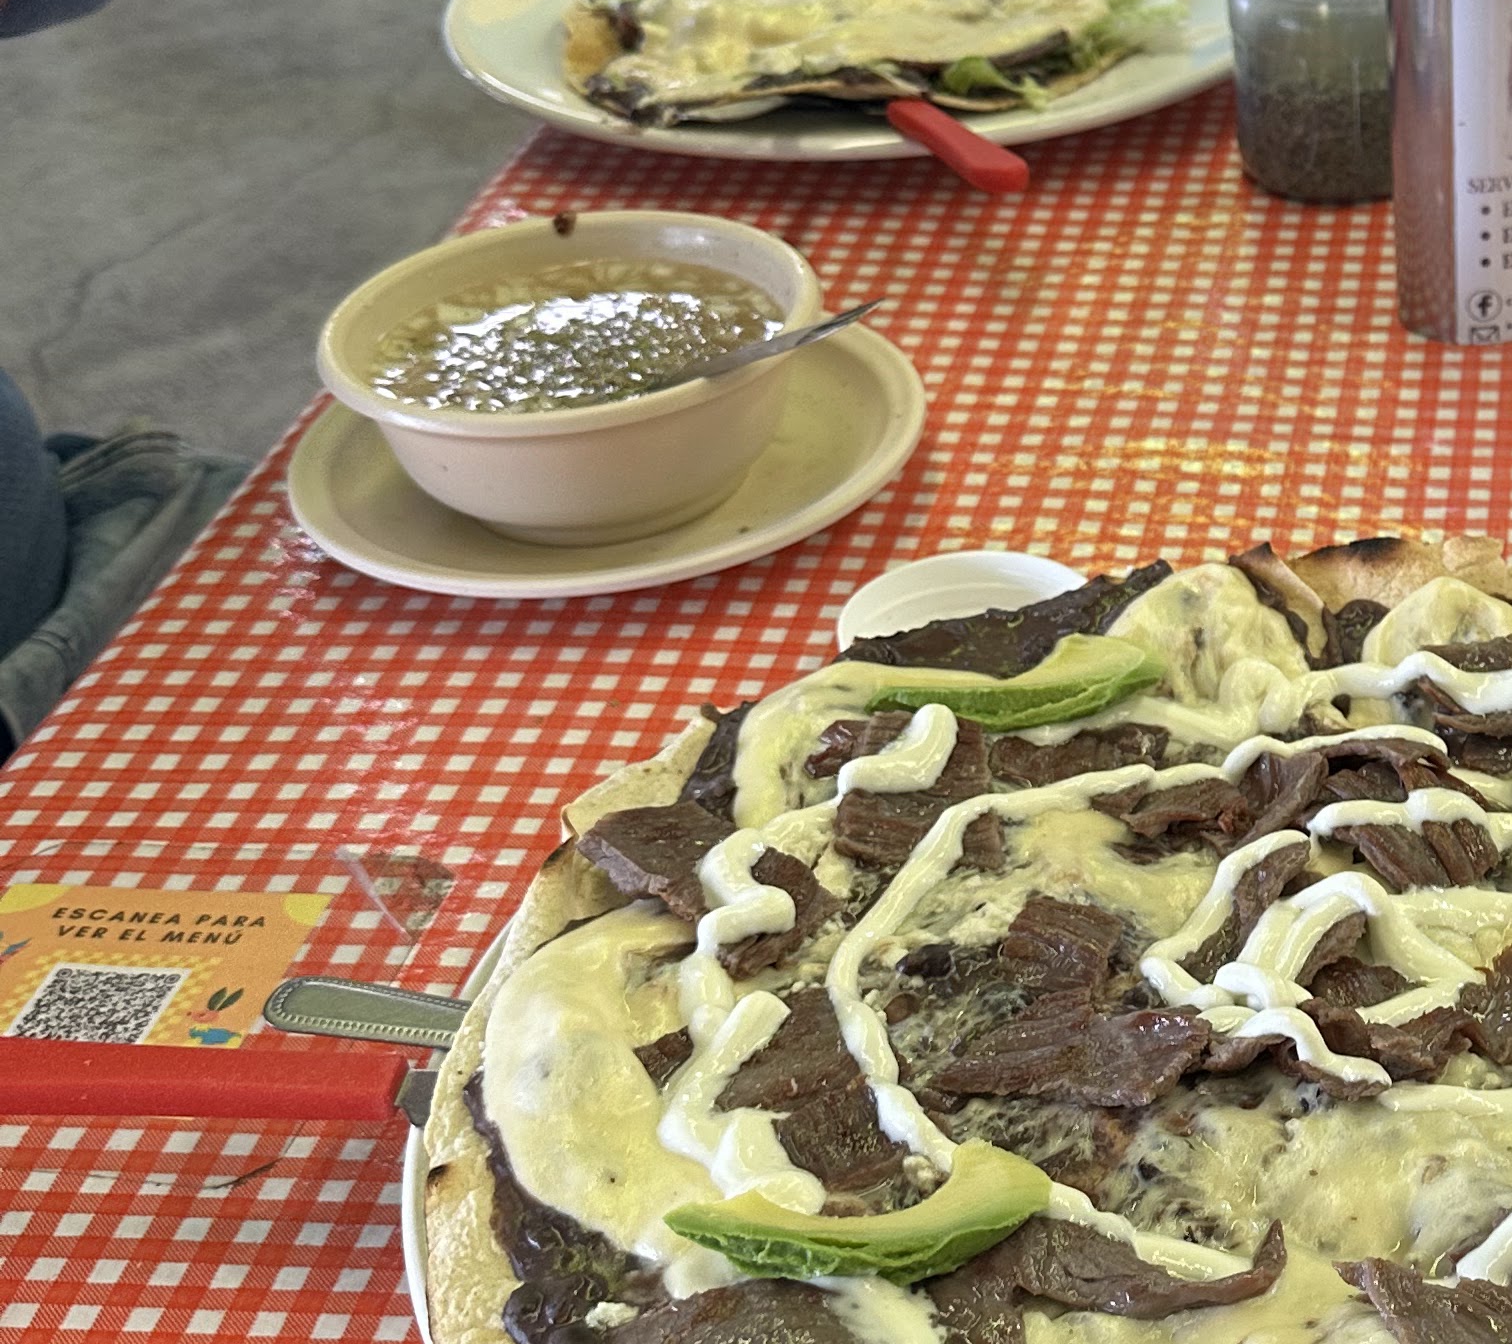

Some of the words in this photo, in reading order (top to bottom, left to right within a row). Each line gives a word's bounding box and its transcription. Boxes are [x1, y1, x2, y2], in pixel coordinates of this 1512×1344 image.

[51, 907, 182, 926] ESCANEA
[195, 913, 266, 928] PARA
[57, 925, 109, 939] VER
[118, 928, 149, 942] EL
[159, 929, 243, 946] MENÚ
